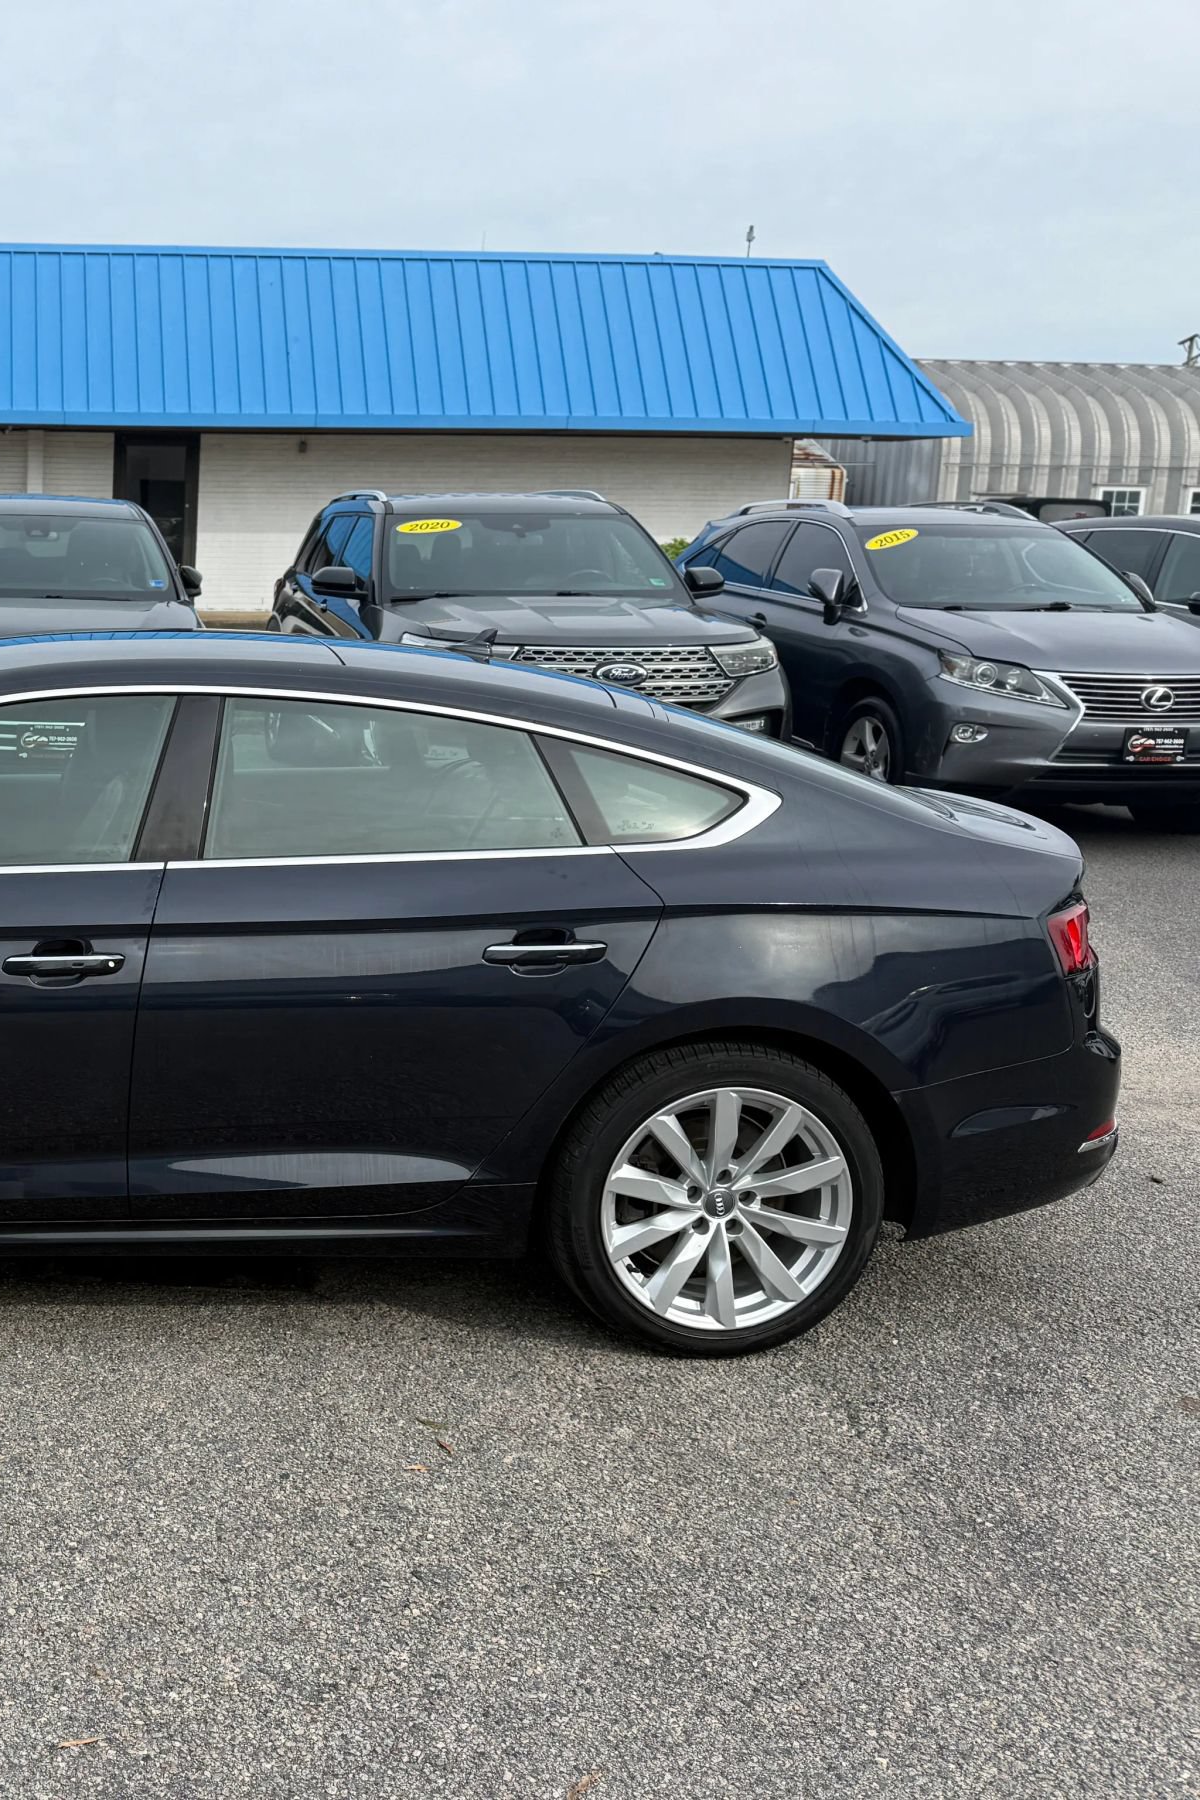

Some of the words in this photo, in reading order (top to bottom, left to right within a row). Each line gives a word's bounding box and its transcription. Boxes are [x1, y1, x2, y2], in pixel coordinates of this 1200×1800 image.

[409, 521, 450, 532] 2020
[875, 531, 910, 547] 2015
[609, 667, 636, 680] Ford
